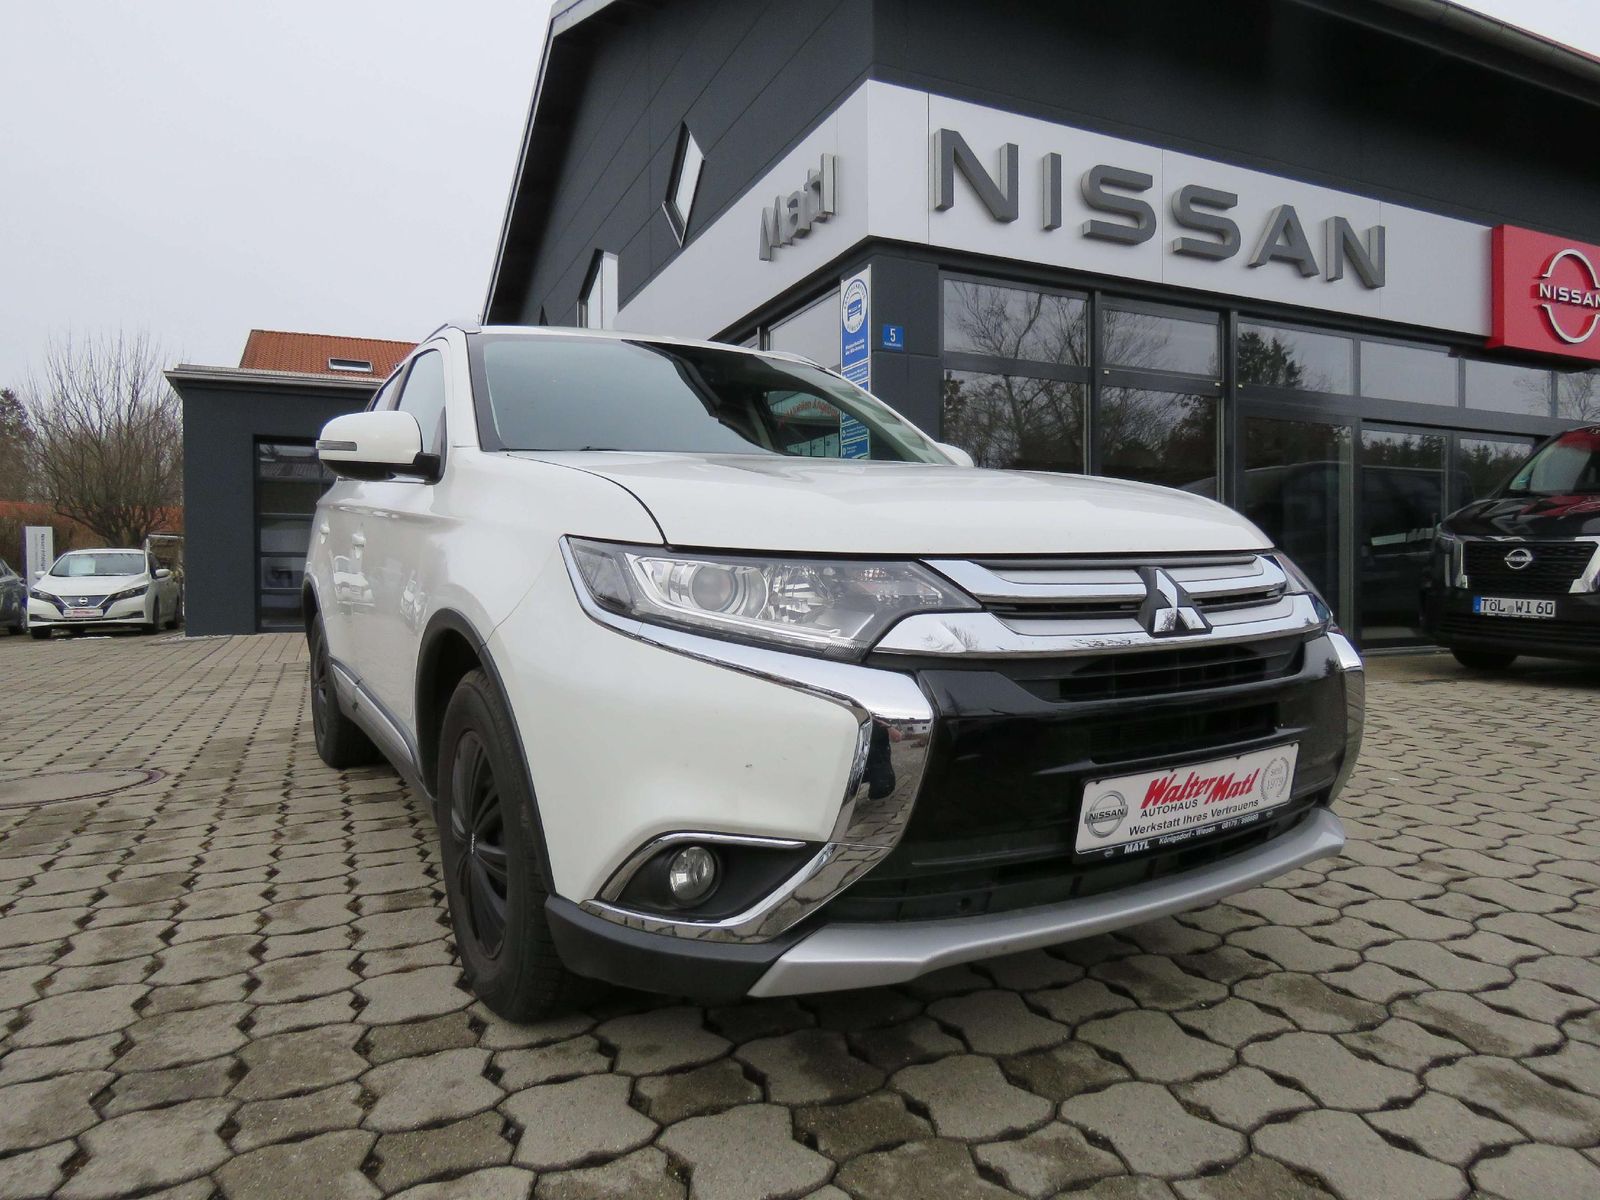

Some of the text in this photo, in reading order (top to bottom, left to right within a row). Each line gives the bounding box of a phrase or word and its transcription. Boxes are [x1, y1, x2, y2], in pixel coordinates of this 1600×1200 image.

[759, 153, 834, 261] Matl
[934, 128, 1385, 289] NISSAN
[889, 328, 896, 342] 5
[1481, 599, 1554, 615] TÖL WI 60
[1140, 768, 1260, 809] Walter Matl
[1089, 808, 1125, 820] NISSAN
[1129, 799, 1259, 836] Werkstatt Ihres Vertrauens
[1140, 799, 1198, 818] AUTOHAUS
[1124, 840, 1150, 854] MATL
